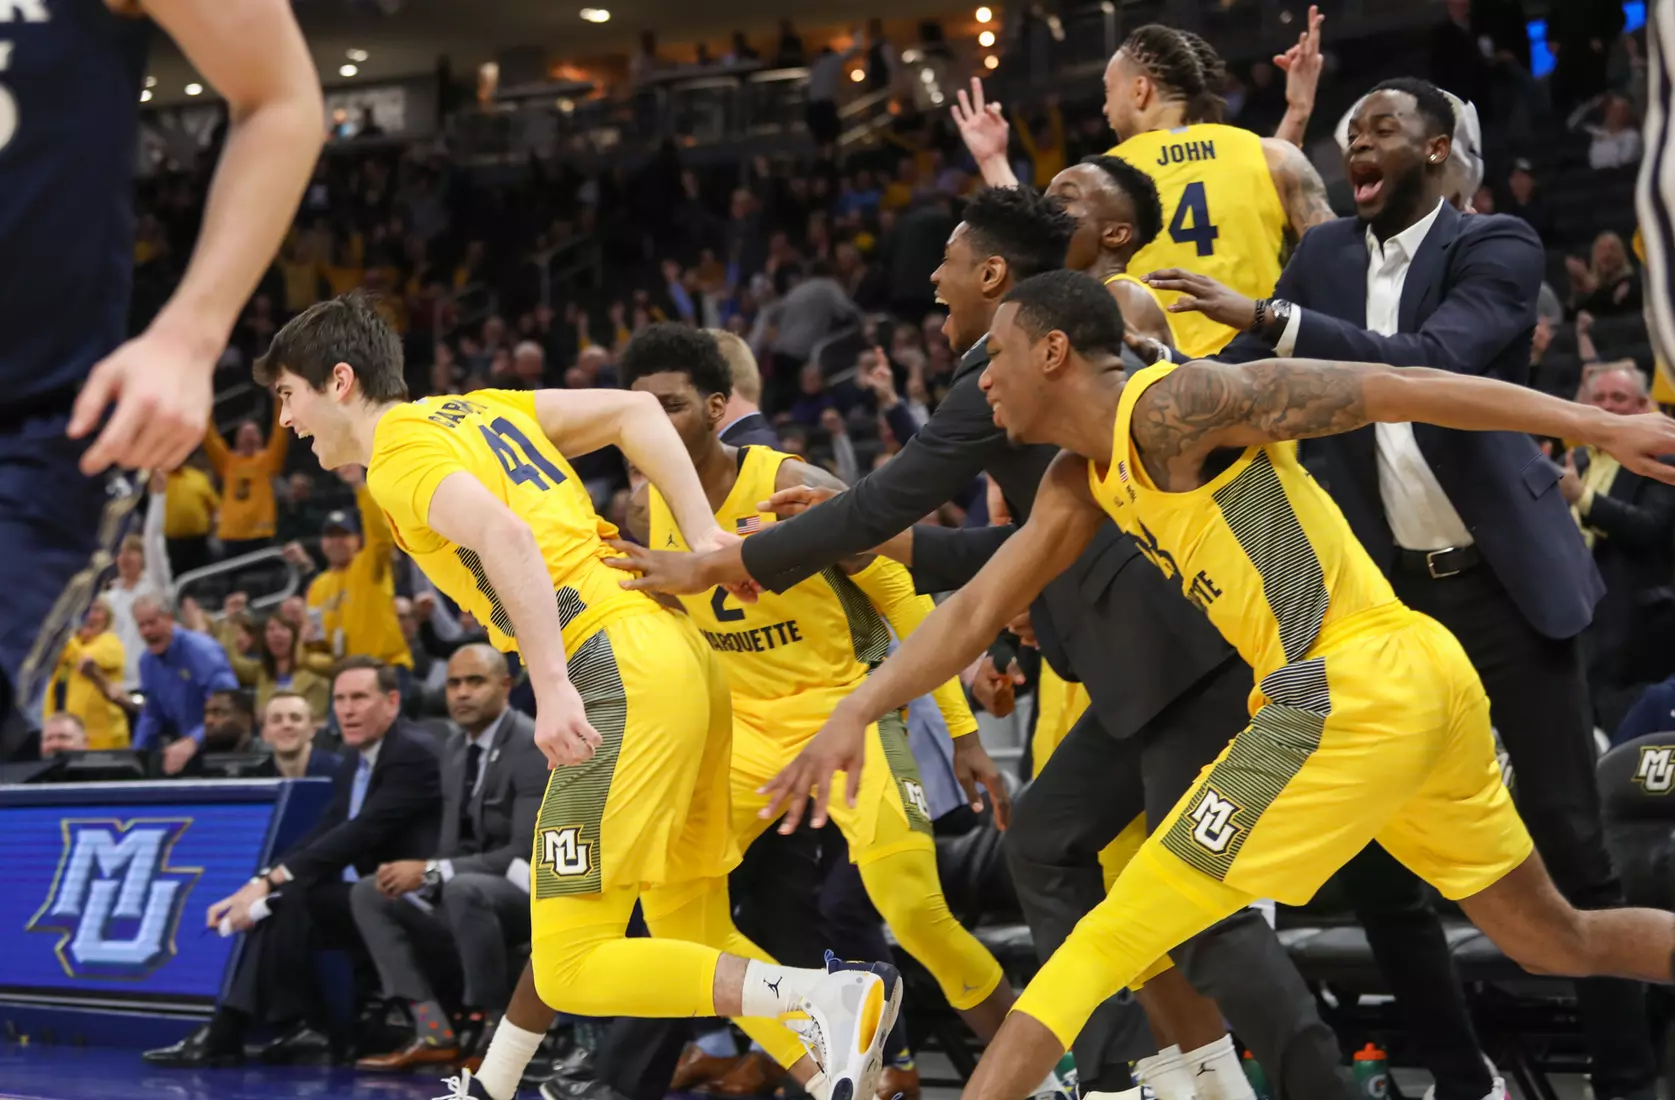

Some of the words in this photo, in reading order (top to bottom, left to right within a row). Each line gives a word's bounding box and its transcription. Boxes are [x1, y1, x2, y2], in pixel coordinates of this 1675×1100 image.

[1157, 139, 1216, 166] JOHN
[1168, 181, 1219, 257] 4
[478, 416, 568, 491] 41
[1635, 747, 1675, 793] MU
[543, 827, 590, 877] MU
[1188, 787, 1240, 854] MU
[44, 824, 187, 969] MU
